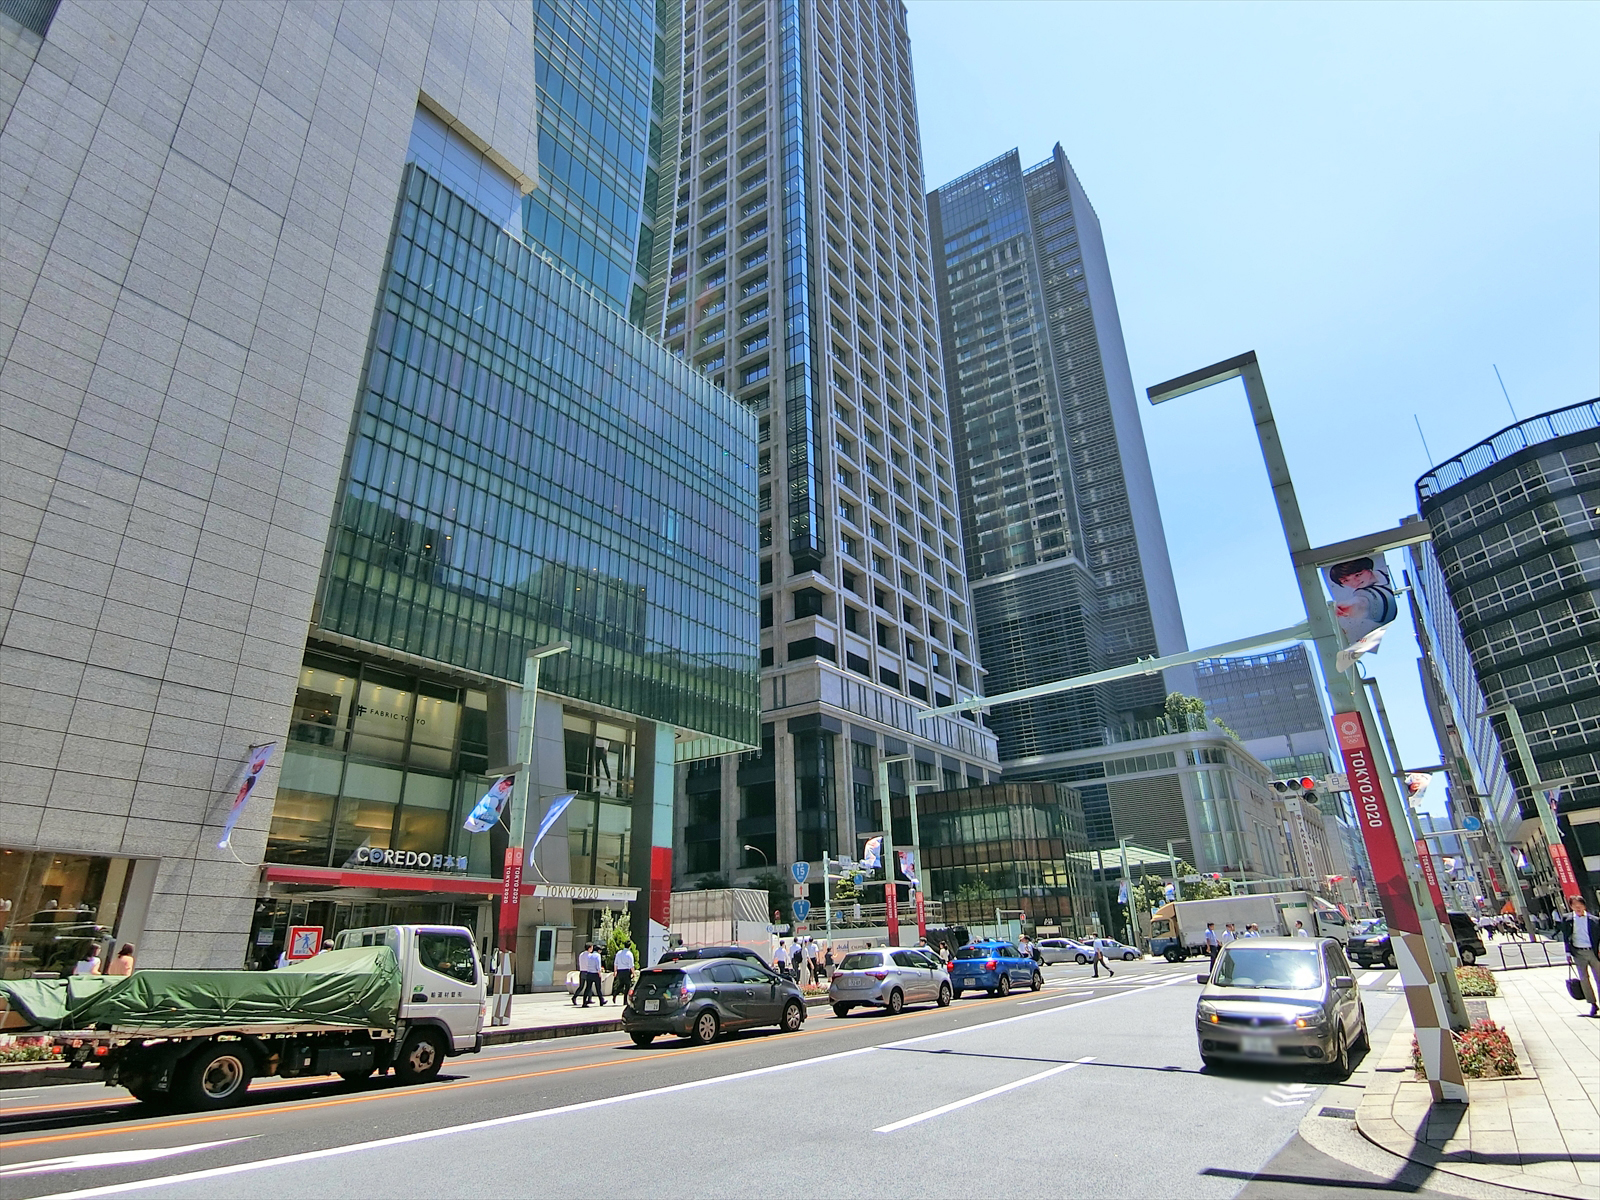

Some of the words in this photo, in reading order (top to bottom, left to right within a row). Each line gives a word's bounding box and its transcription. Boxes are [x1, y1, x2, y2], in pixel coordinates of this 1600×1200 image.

[370, 708, 399, 720] FABRIC
[401, 715, 426, 726] TOYO
[1350, 751, 1373, 793] TOKYO
[1361, 795, 1383, 828] 2020
[357, 846, 431, 867] COREDO
[503, 866, 511, 888] TOKYO
[513, 866, 521, 888] TOKYO
[796, 867, 805, 876] 15
[546, 885, 576, 898] TOKYO
[577, 888, 599, 899] 2020
